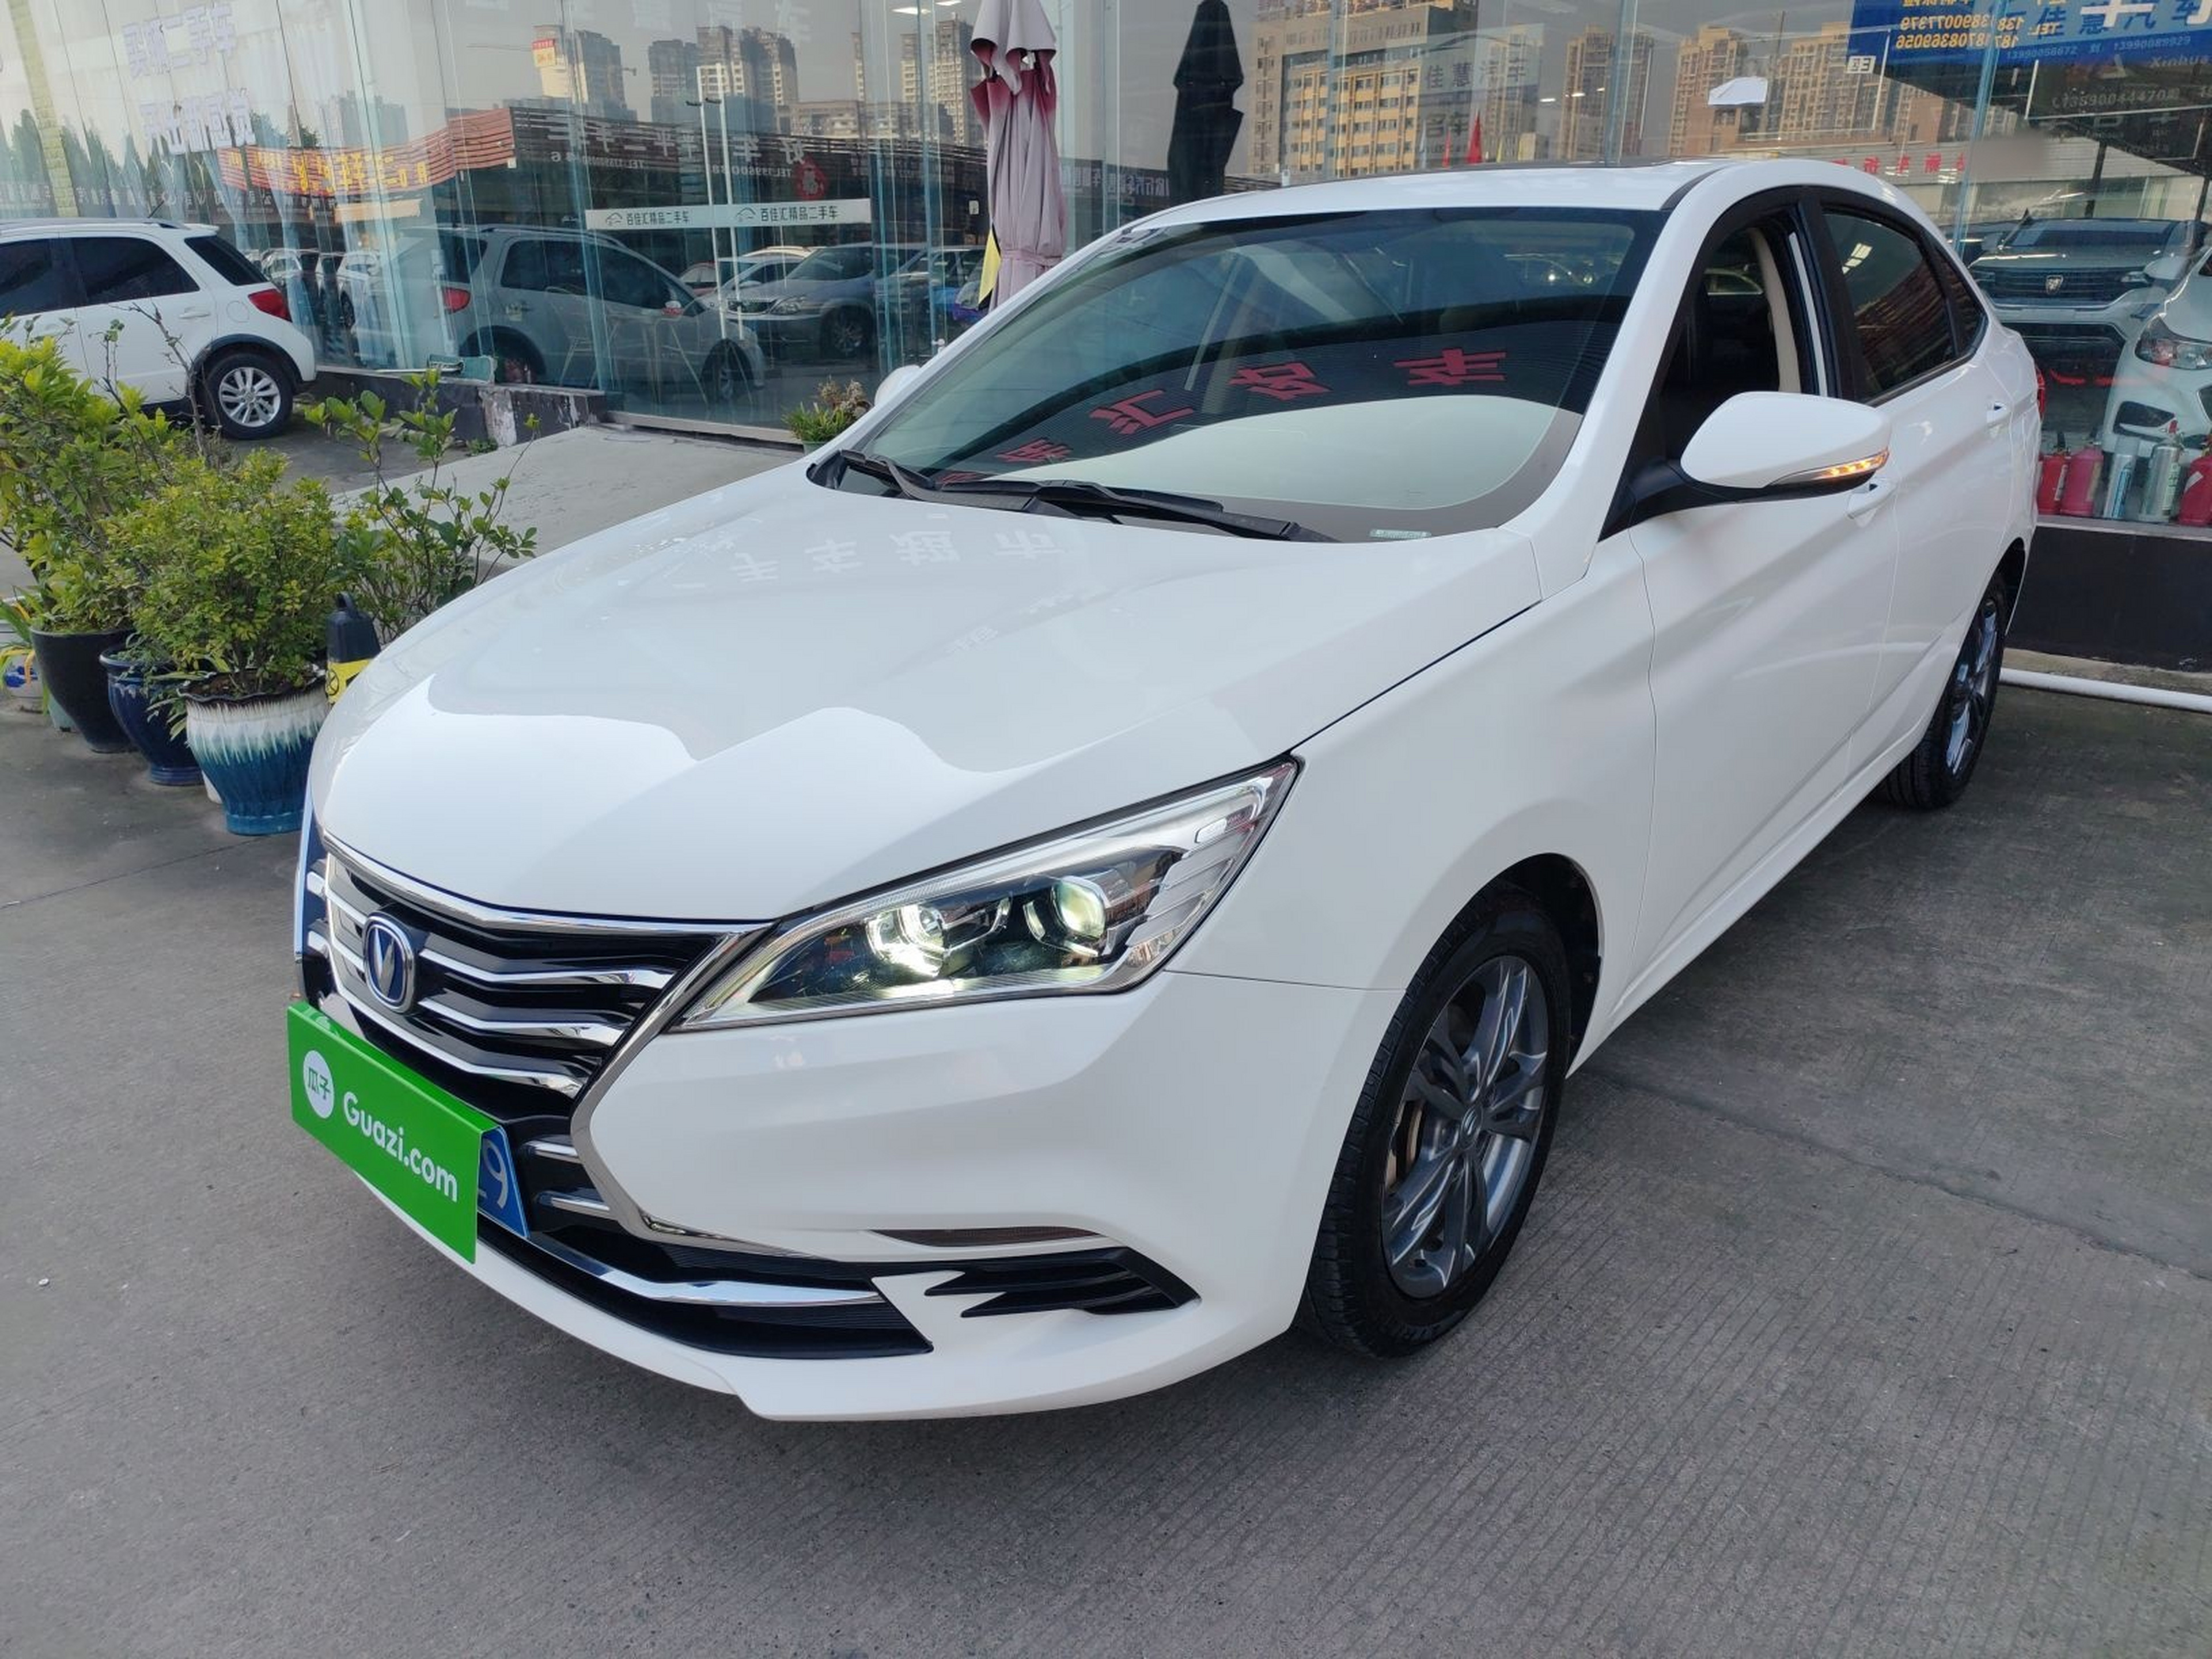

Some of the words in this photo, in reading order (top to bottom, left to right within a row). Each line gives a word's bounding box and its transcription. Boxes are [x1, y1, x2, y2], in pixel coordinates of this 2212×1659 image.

[627, 211, 690, 226] 百佳汇精品二手车
[760, 205, 838, 222] 百佳汇精品二手车
[308, 1067, 330, 1100] 瓜子
[343, 1092, 458, 1202] Guazi.com
